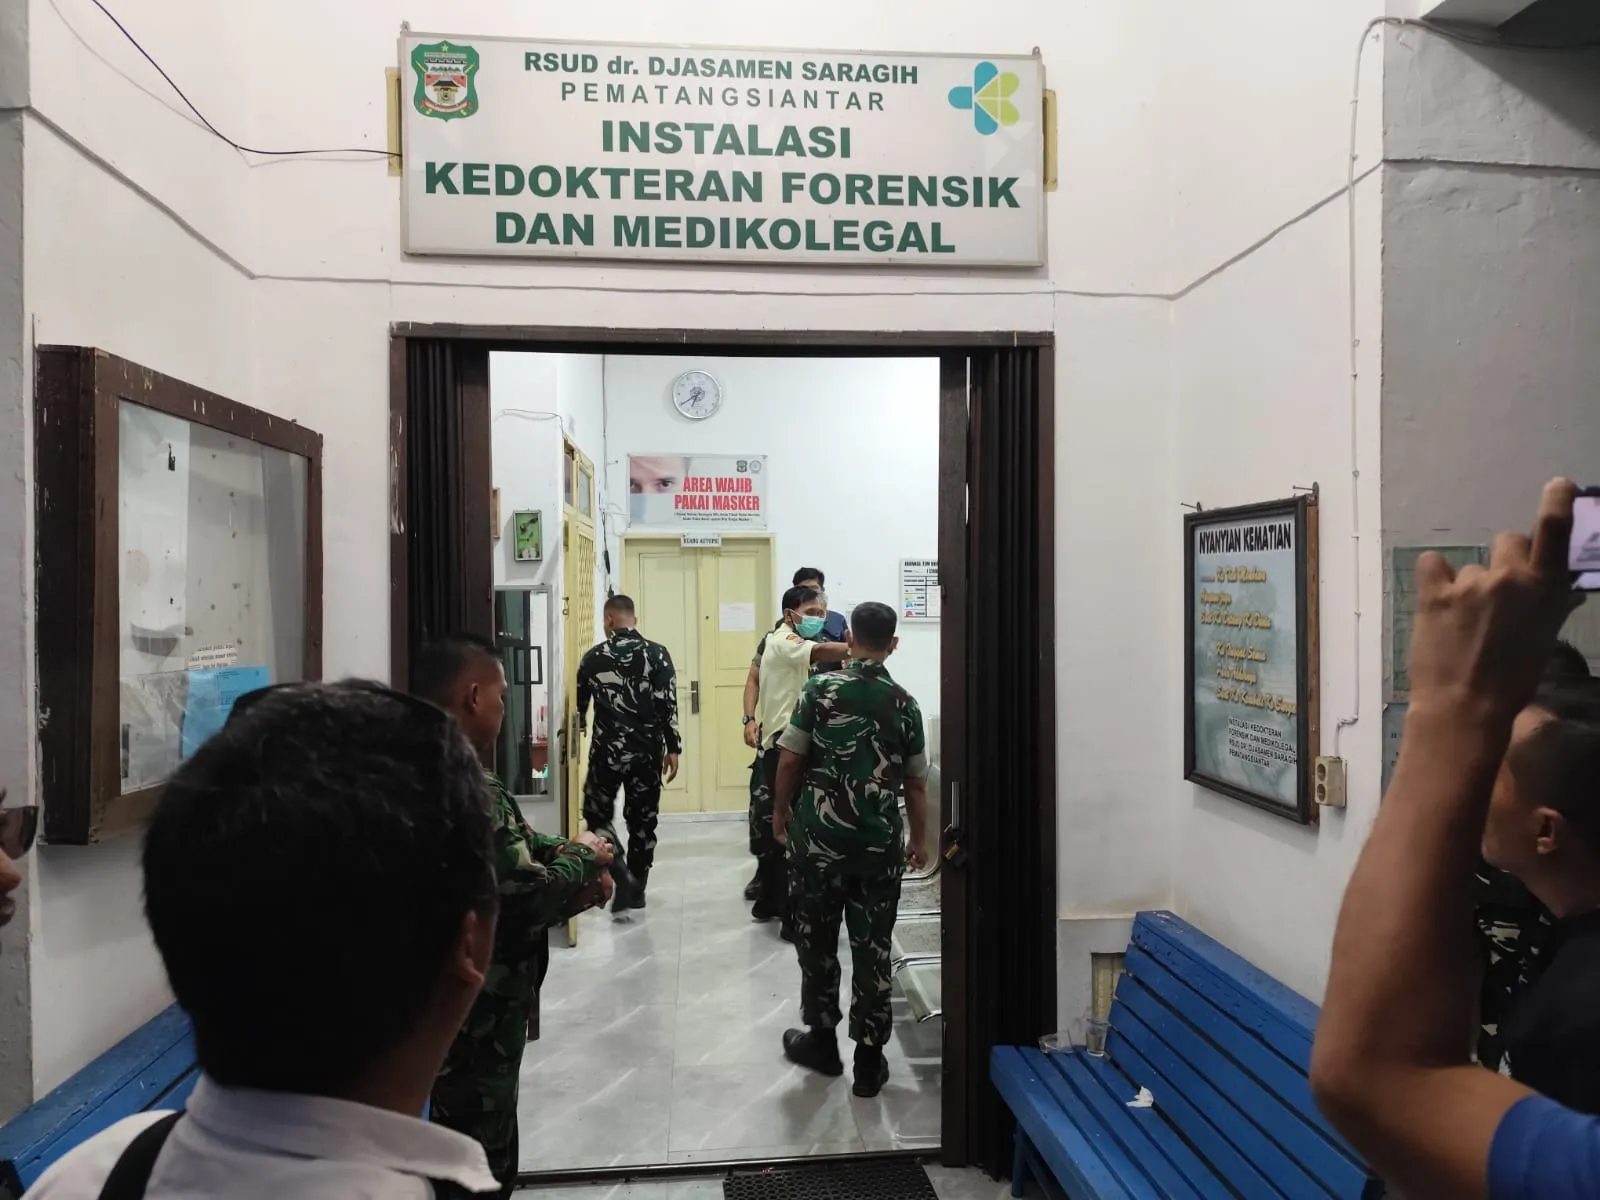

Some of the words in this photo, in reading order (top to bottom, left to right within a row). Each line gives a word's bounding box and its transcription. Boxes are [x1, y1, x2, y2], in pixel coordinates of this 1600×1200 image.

[524, 52, 598, 73] RSUD
[607, 55, 639, 75] dr.
[648, 56, 793, 80] DJASAMEN
[801, 61, 918, 85] SARAGIH
[561, 82, 884, 111] PEMATANGSIANTAR
[602, 120, 851, 158] INSTALASI
[425, 161, 763, 203] KEDOKTERAN
[781, 172, 1020, 208] FORENSIK
[496, 212, 594, 246] DAN
[613, 215, 956, 253] MEDIKOLEGAL
[683, 477, 712, 492] AREA
[715, 477, 752, 493] WAJIB
[674, 495, 710, 509] PAKAI
[713, 495, 759, 510] MASKER
[1199, 528, 1241, 554] NYANYIAN
[1243, 522, 1291, 552] KEMATIAN
[1250, 724, 1282, 738] KEDOKTERAN
[1261, 737, 1296, 753] MEDIKOLEGAL
